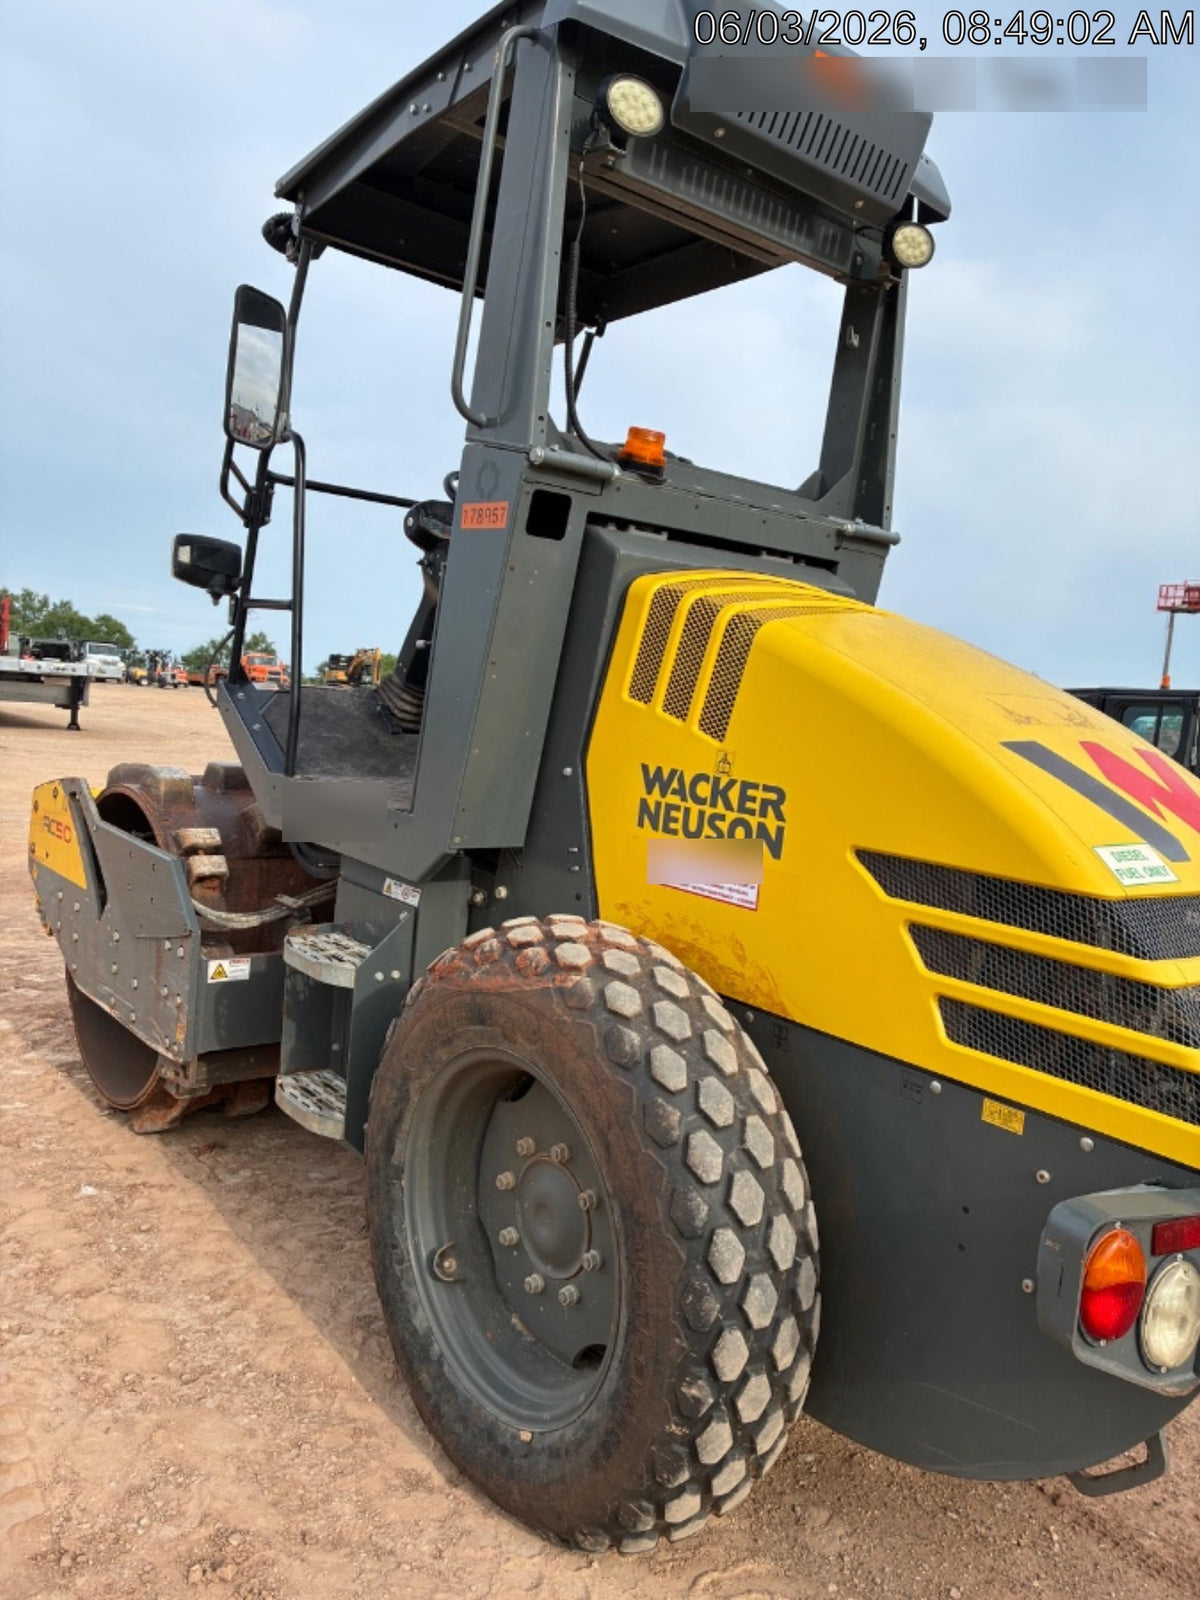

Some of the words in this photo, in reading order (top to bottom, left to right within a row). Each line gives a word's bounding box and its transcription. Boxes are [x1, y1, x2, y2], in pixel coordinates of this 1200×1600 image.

[463, 506, 506, 525] 178957
[640, 762, 787, 822] WACKER
[636, 797, 785, 860] NEUSON
[1110, 849, 1150, 863] DIESEL
[1114, 867, 1146, 880] FUEL
[1142, 865, 1170, 877] ONLY
